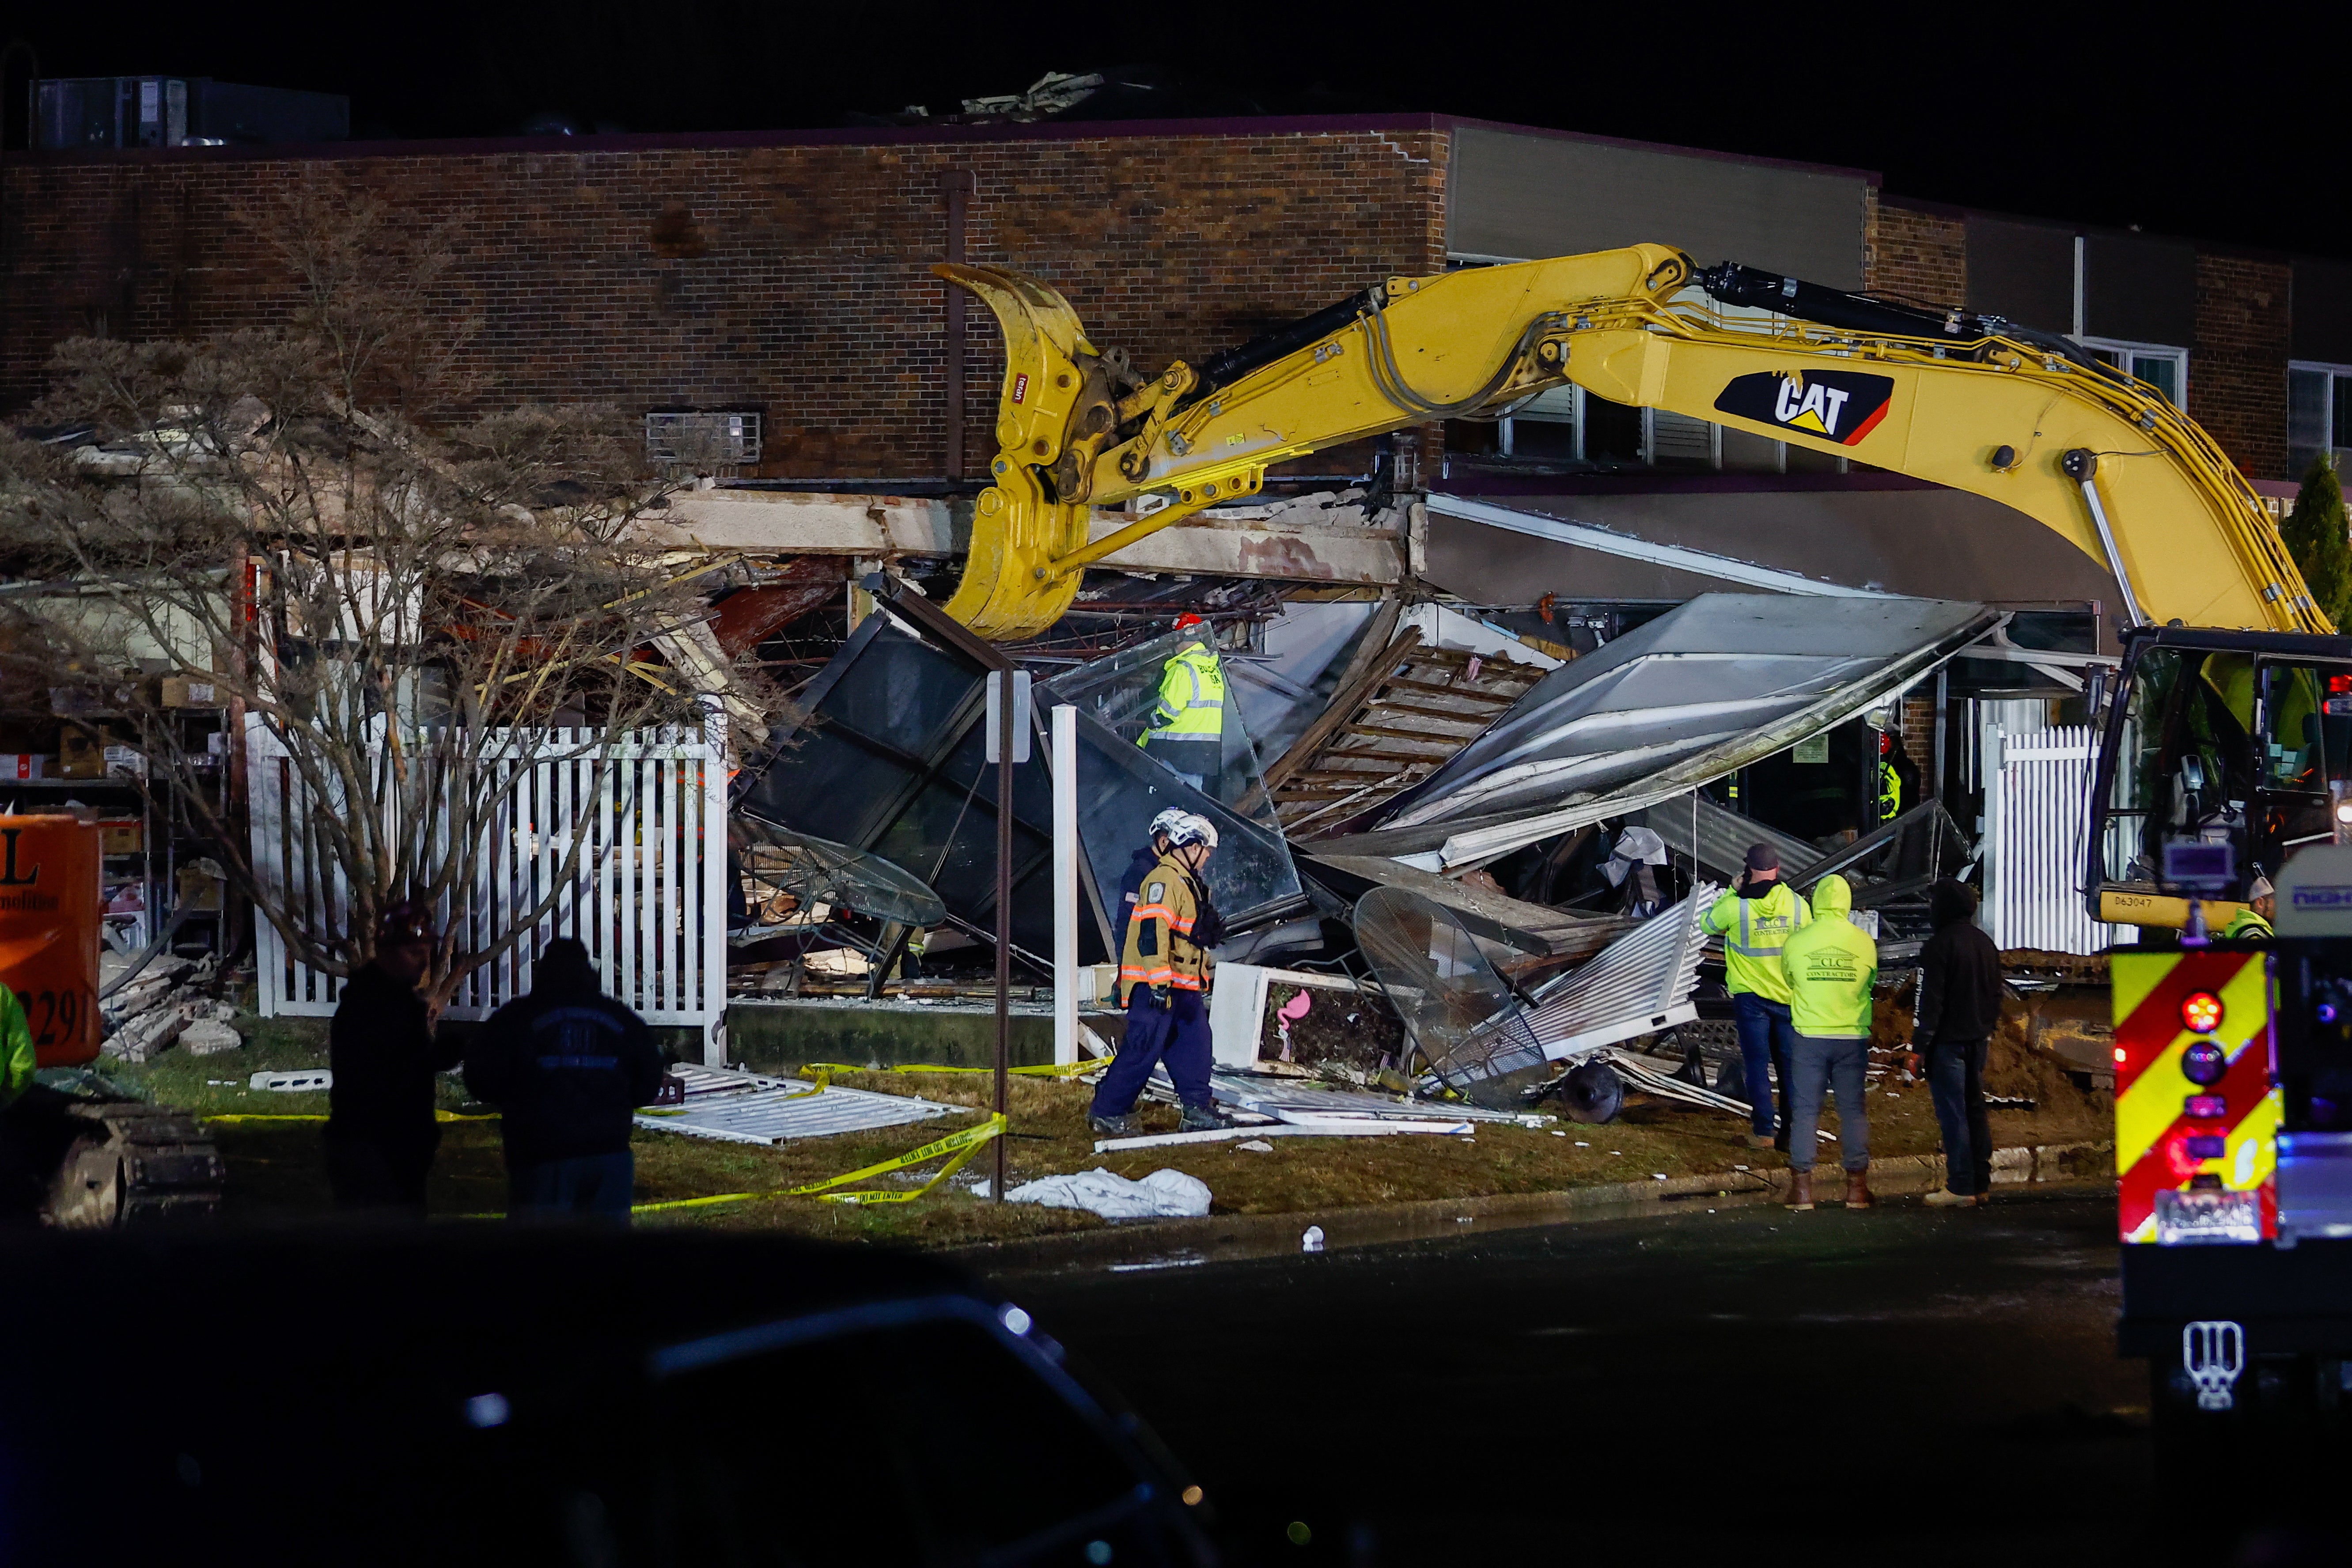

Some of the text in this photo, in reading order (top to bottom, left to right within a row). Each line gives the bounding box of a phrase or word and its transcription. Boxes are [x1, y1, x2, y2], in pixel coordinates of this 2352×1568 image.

[1014, 377, 1026, 400] teran
[1775, 377, 1849, 435] CAT
[1764, 919, 1779, 927] CLC
[1821, 958, 1844, 967] CLC
